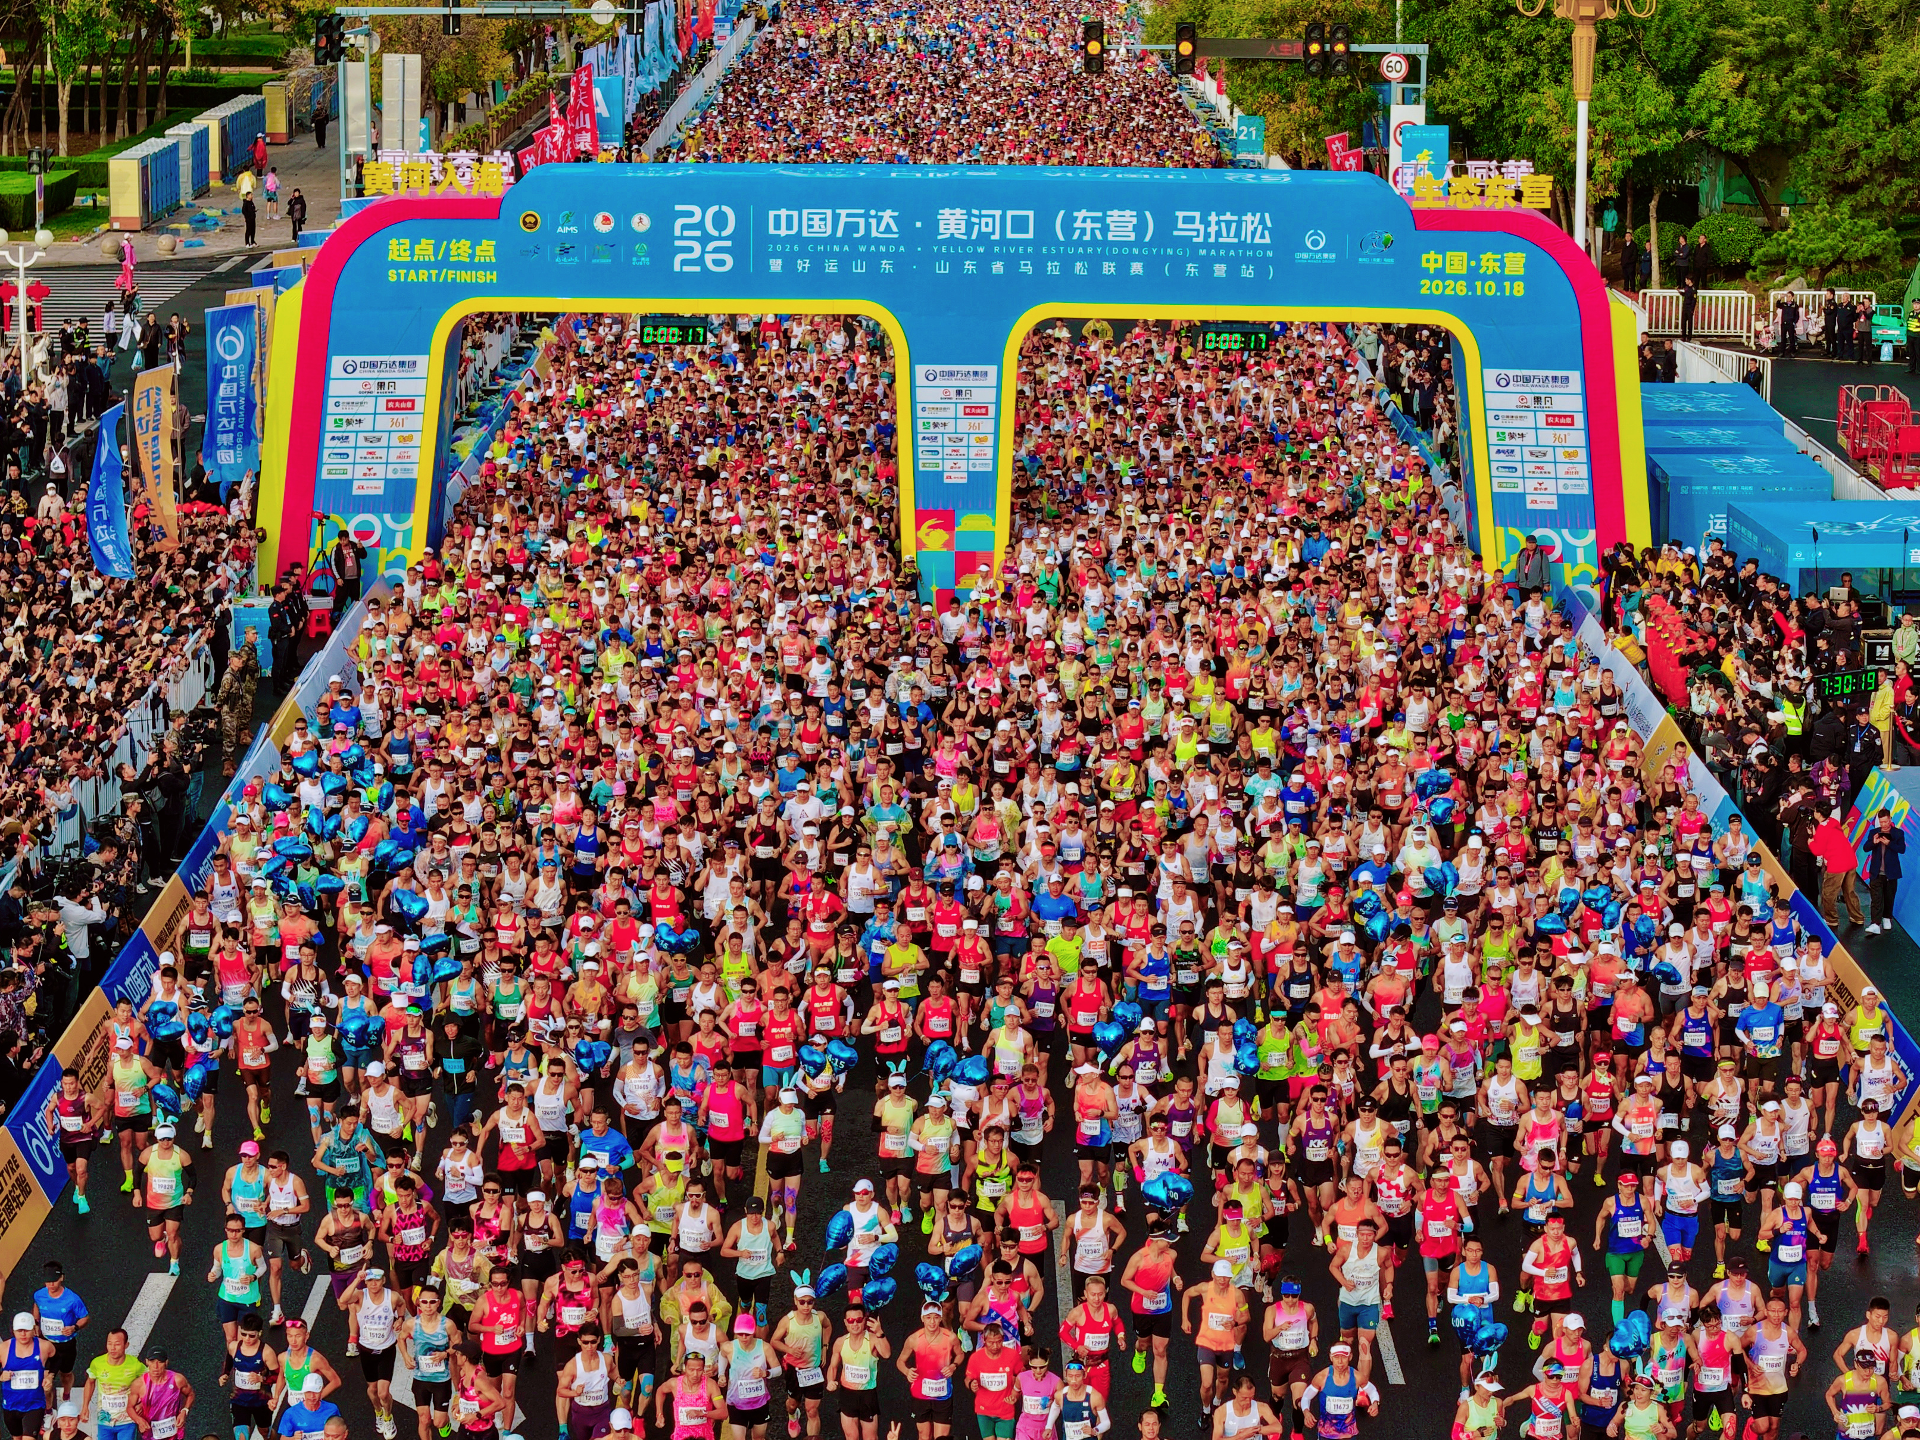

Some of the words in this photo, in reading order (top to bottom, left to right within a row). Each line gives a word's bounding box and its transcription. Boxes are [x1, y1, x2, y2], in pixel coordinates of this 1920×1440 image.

[1386, 60, 1403, 73] 60
[362, 161, 503, 196] 黄河入海
[1412, 173, 1554, 209] 生态东营
[556, 226, 579, 234] AIMS
[388, 239, 497, 262] 起点/终点
[768, 244, 799, 252] 2026
[808, 244, 850, 252] CHINA
[858, 245, 905, 253] WANDA
[933, 245, 985, 254] YELLOW
[994, 246, 1034, 254] RIVER
[1199, 249, 1273, 257] MARATHON
[1421, 251, 1526, 275] 中国·东营
[388, 269, 497, 283] START/FINISH
[1420, 279, 1525, 296] 2026.10.18
[643, 326, 704, 344] 0:00:17
[1205, 332, 1266, 350] 0:00:17
[360, 360, 417, 369] 中国万达集团
[1512, 374, 1570, 384] 中国万达集团
[1821, 671, 1876, 696] 7:30:19
[344, 756, 357, 766] 5:00
